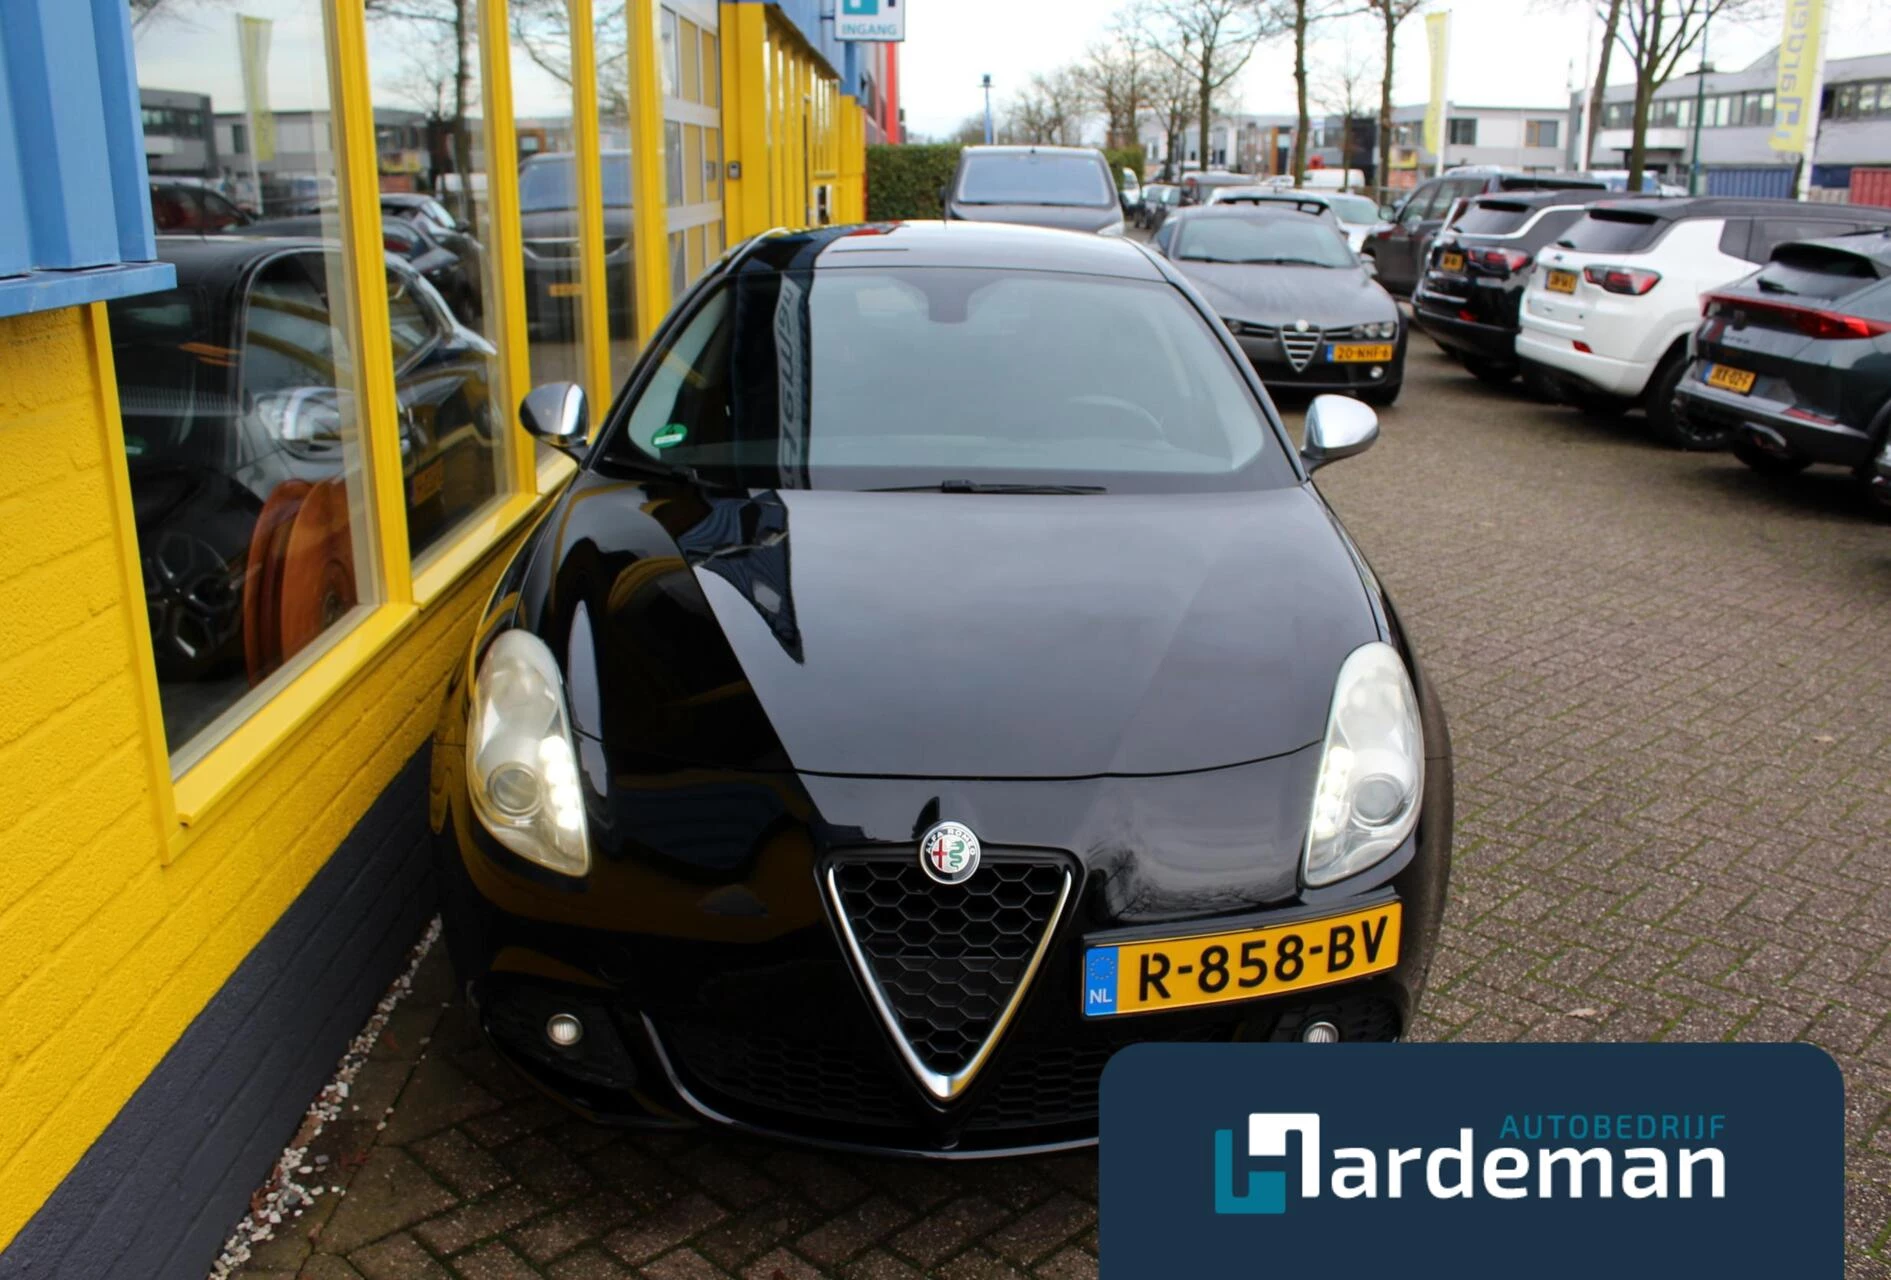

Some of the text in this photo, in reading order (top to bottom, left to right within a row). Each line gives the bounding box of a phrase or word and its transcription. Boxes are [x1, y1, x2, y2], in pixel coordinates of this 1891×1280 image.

[842, 24, 897, 35] INGANG
[926, 829, 976, 856] ALFA ROMEO
[1090, 915, 1388, 1004] NL R-858-BV
